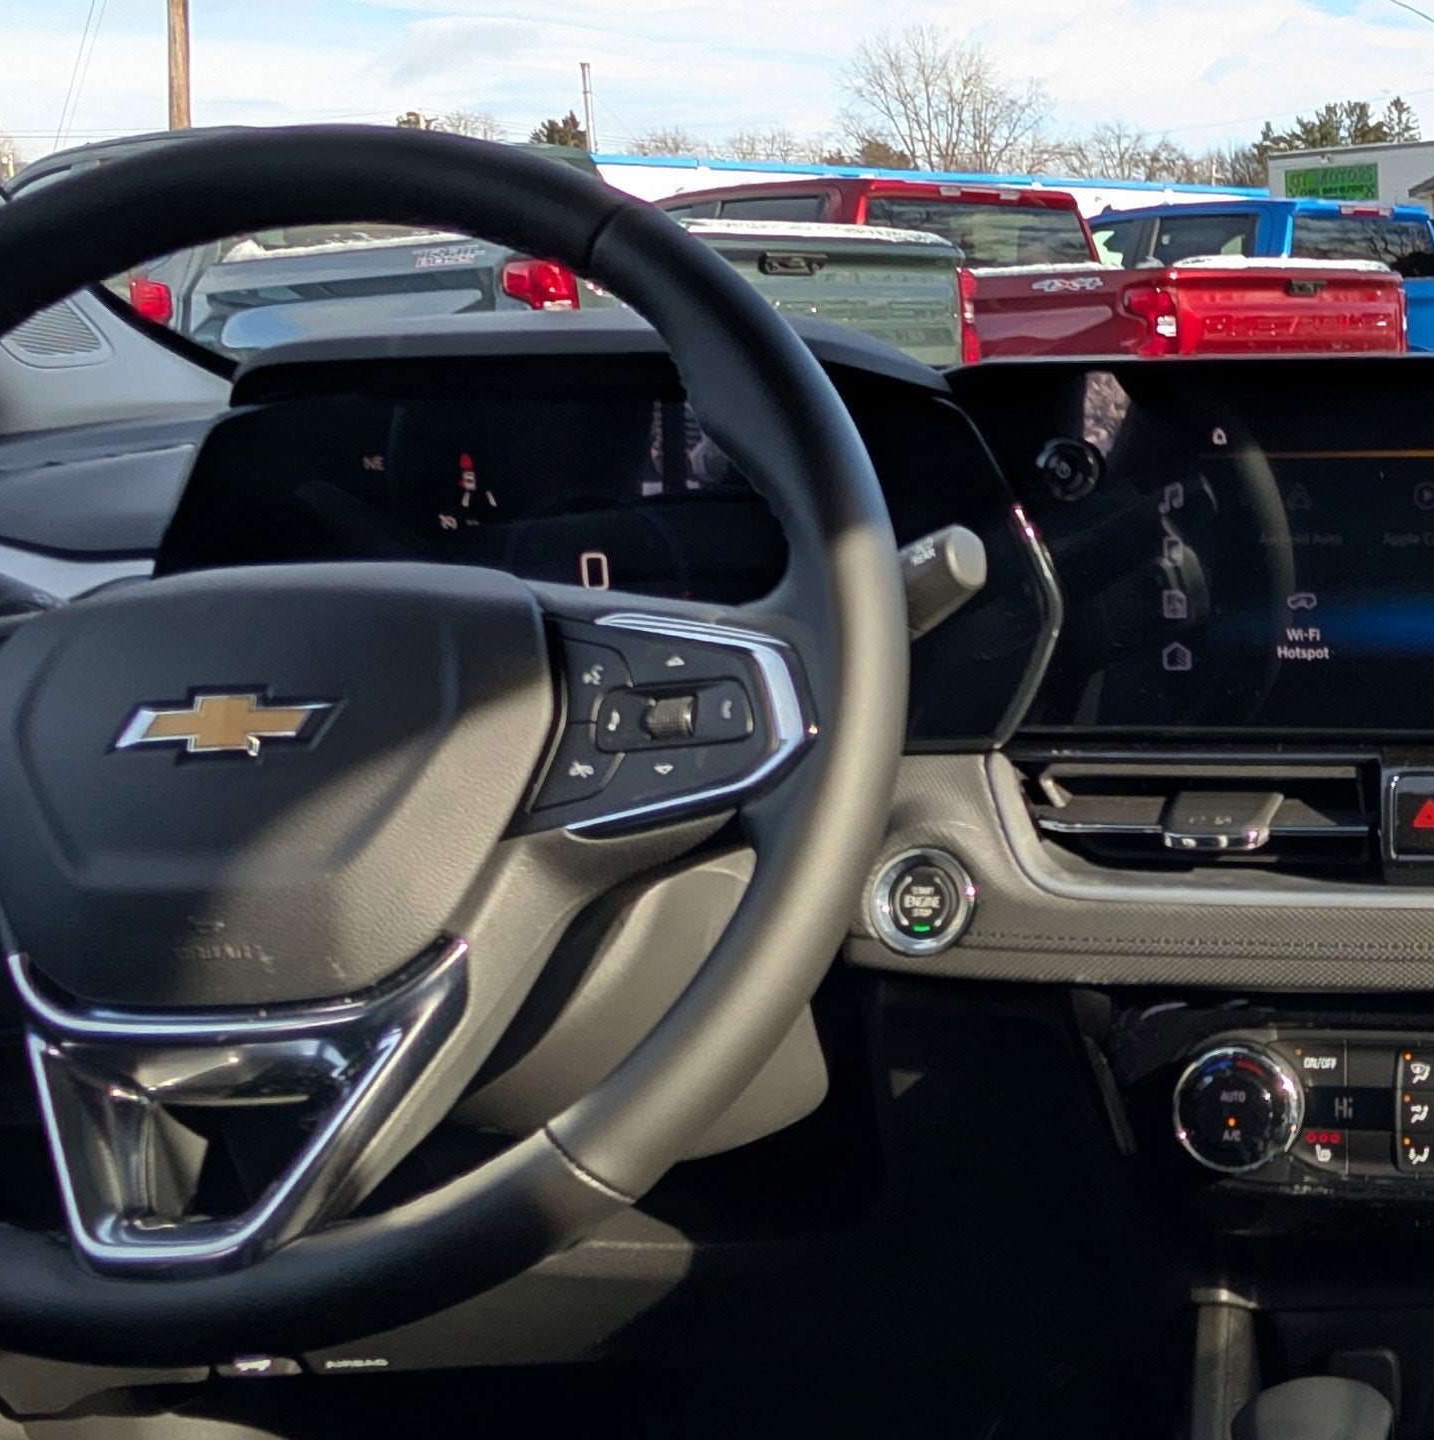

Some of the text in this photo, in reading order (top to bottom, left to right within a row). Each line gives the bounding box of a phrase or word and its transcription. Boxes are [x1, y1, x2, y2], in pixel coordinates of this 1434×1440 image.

[1384, 532, 1419, 547] Apple
[580, 551, 609, 591] 0
[1286, 628, 1320, 641] Wi-Fi
[1277, 646, 1329, 661] Hotspot
[904, 895, 941, 907] ENGINE
[1304, 1057, 1336, 1070] ON/OFF
[1220, 1091, 1246, 1102] AUTO
[1222, 1130, 1241, 1142] A/C
